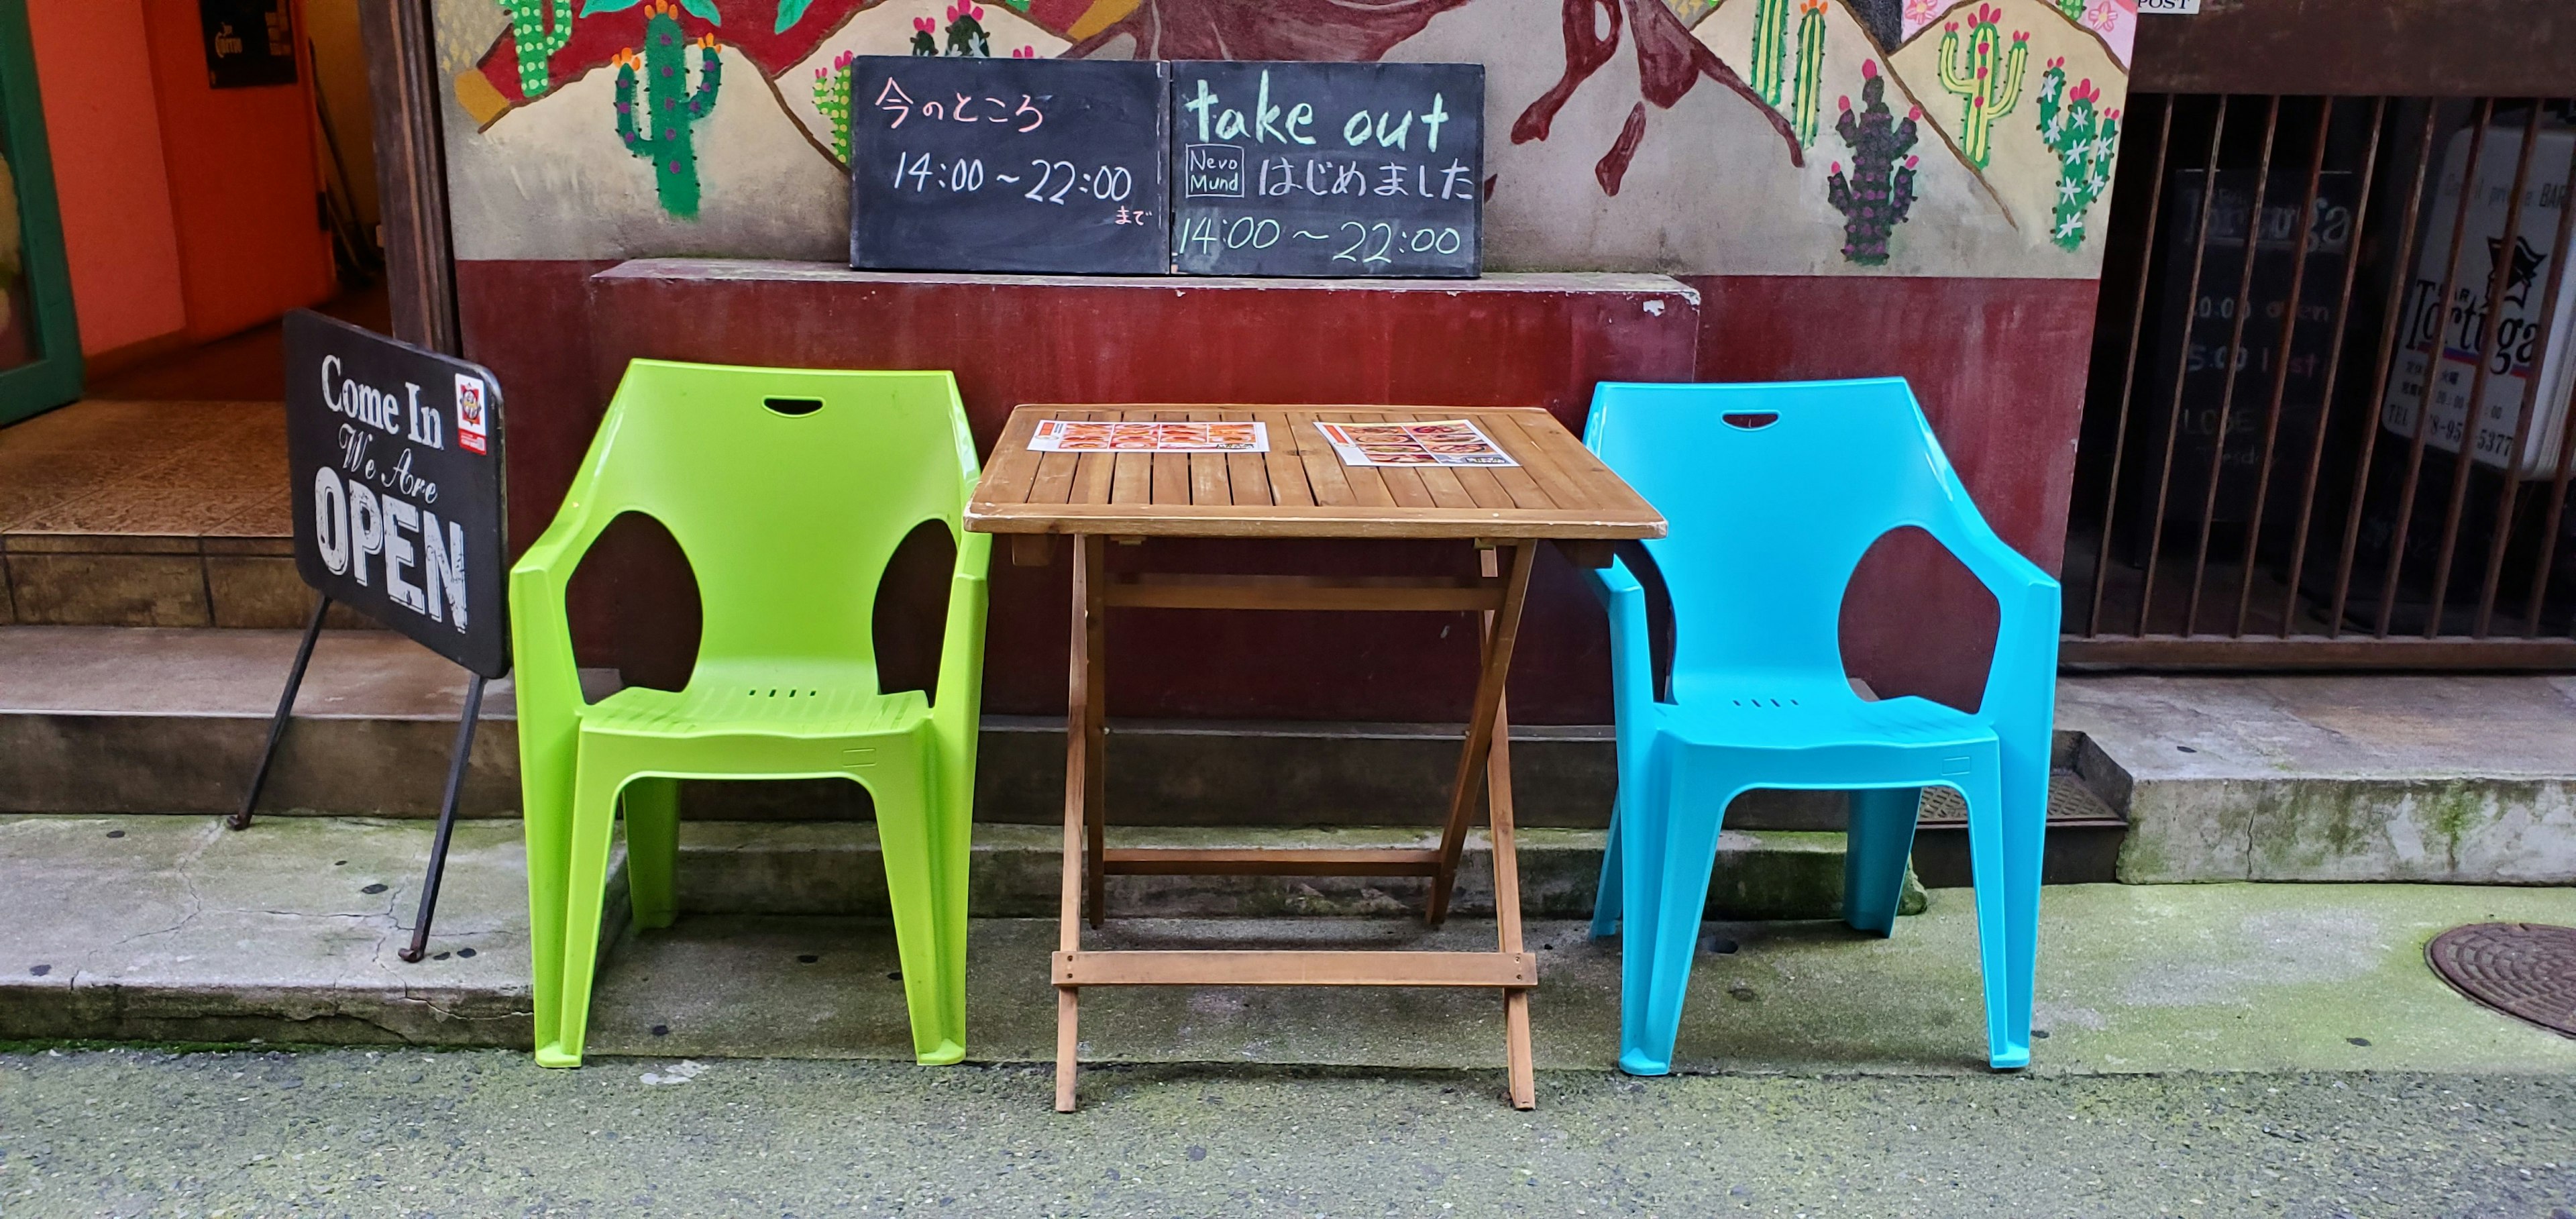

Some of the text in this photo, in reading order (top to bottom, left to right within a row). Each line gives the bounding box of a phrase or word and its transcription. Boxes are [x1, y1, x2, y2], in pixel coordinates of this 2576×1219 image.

[875, 76, 1043, 133] 今のところ
[1185, 69, 1450, 153] take out
[1189, 149, 1238, 171] Nevo
[1190, 174, 1238, 193] Mund
[1259, 156, 1473, 200] はじめました
[1114, 205, 1152, 226] まで
[321, 354, 445, 452] Come In
[338, 423, 438, 505] We Are
[315, 466, 468, 634] OPEN
